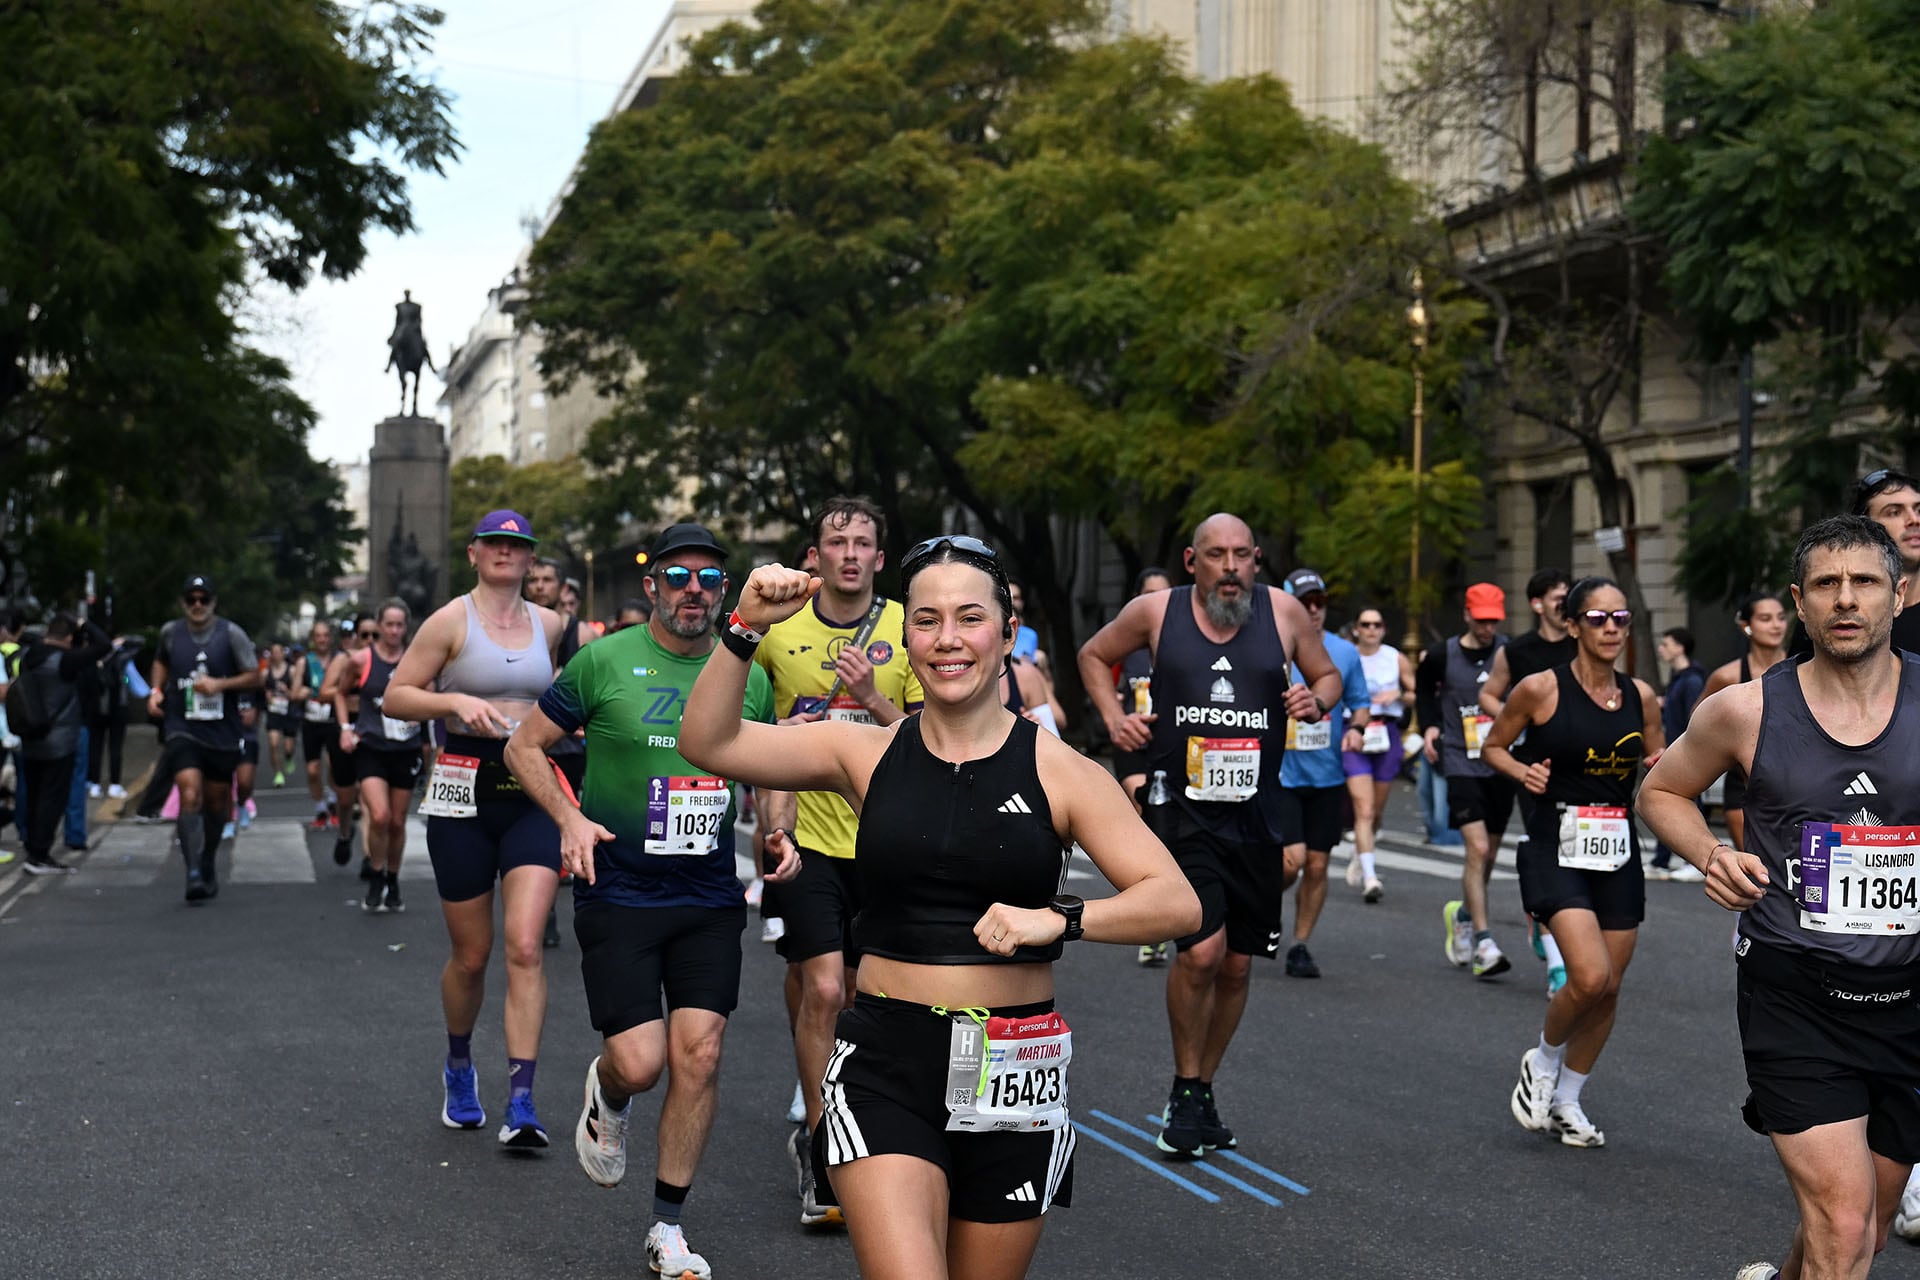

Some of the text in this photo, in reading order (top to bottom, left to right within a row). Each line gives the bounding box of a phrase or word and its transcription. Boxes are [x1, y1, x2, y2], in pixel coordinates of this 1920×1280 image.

[1175, 705, 1269, 729] personal
[1223, 754, 1253, 763] MARCELO
[1209, 768, 1254, 787] 13135
[432, 783, 471, 804] 12658
[689, 796, 726, 807] FREDERICO
[1582, 837, 1626, 856] 15014
[1810, 835, 1822, 857] F
[1865, 833, 1900, 841] personal
[1865, 853, 1915, 868] LISANDRO
[1840, 876, 1918, 910] 11364
[1018, 1021, 1049, 1033] personal
[960, 1031, 975, 1056] H
[1016, 1043, 1062, 1062] MARTINA
[990, 1067, 1060, 1108] 15423
